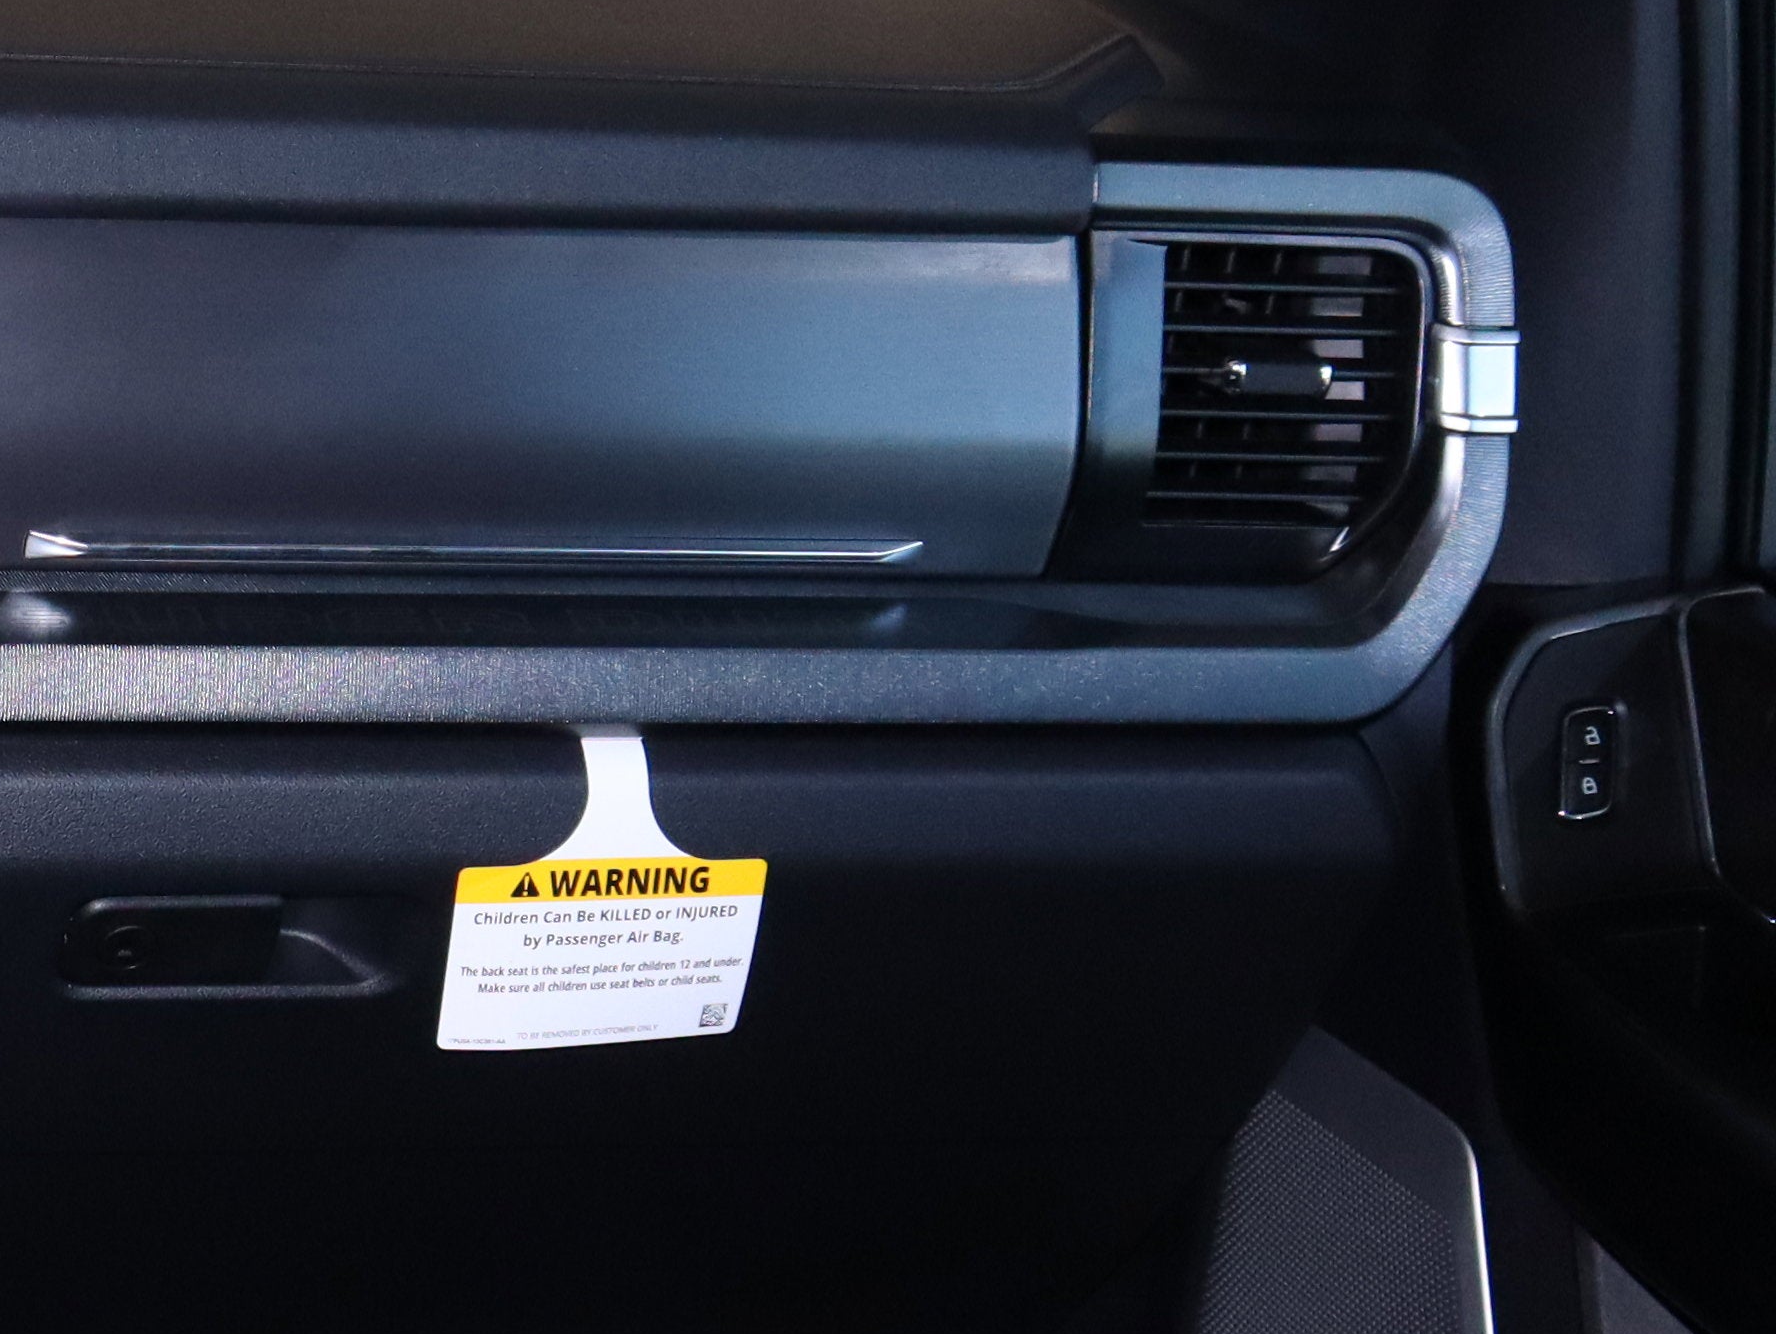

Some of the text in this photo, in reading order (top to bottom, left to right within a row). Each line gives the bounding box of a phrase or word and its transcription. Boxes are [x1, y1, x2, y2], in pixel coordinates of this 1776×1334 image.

[550, 866, 711, 897] WARNING
[474, 905, 739, 925] Children Can Be KILLED or INJURED
[523, 930, 684, 950] by Passenger Air Bag.
[460, 956, 744, 977] The back seat is the safest place for children 12 and under.
[477, 974, 722, 993] Make sure all children use seat belts or child seats.
[517, 1032, 529, 1040] TO
[541, 1030, 580, 1038] REMOVED
[593, 1025, 636, 1035] CUSTOMER
[637, 1024, 659, 1032] ONLY
